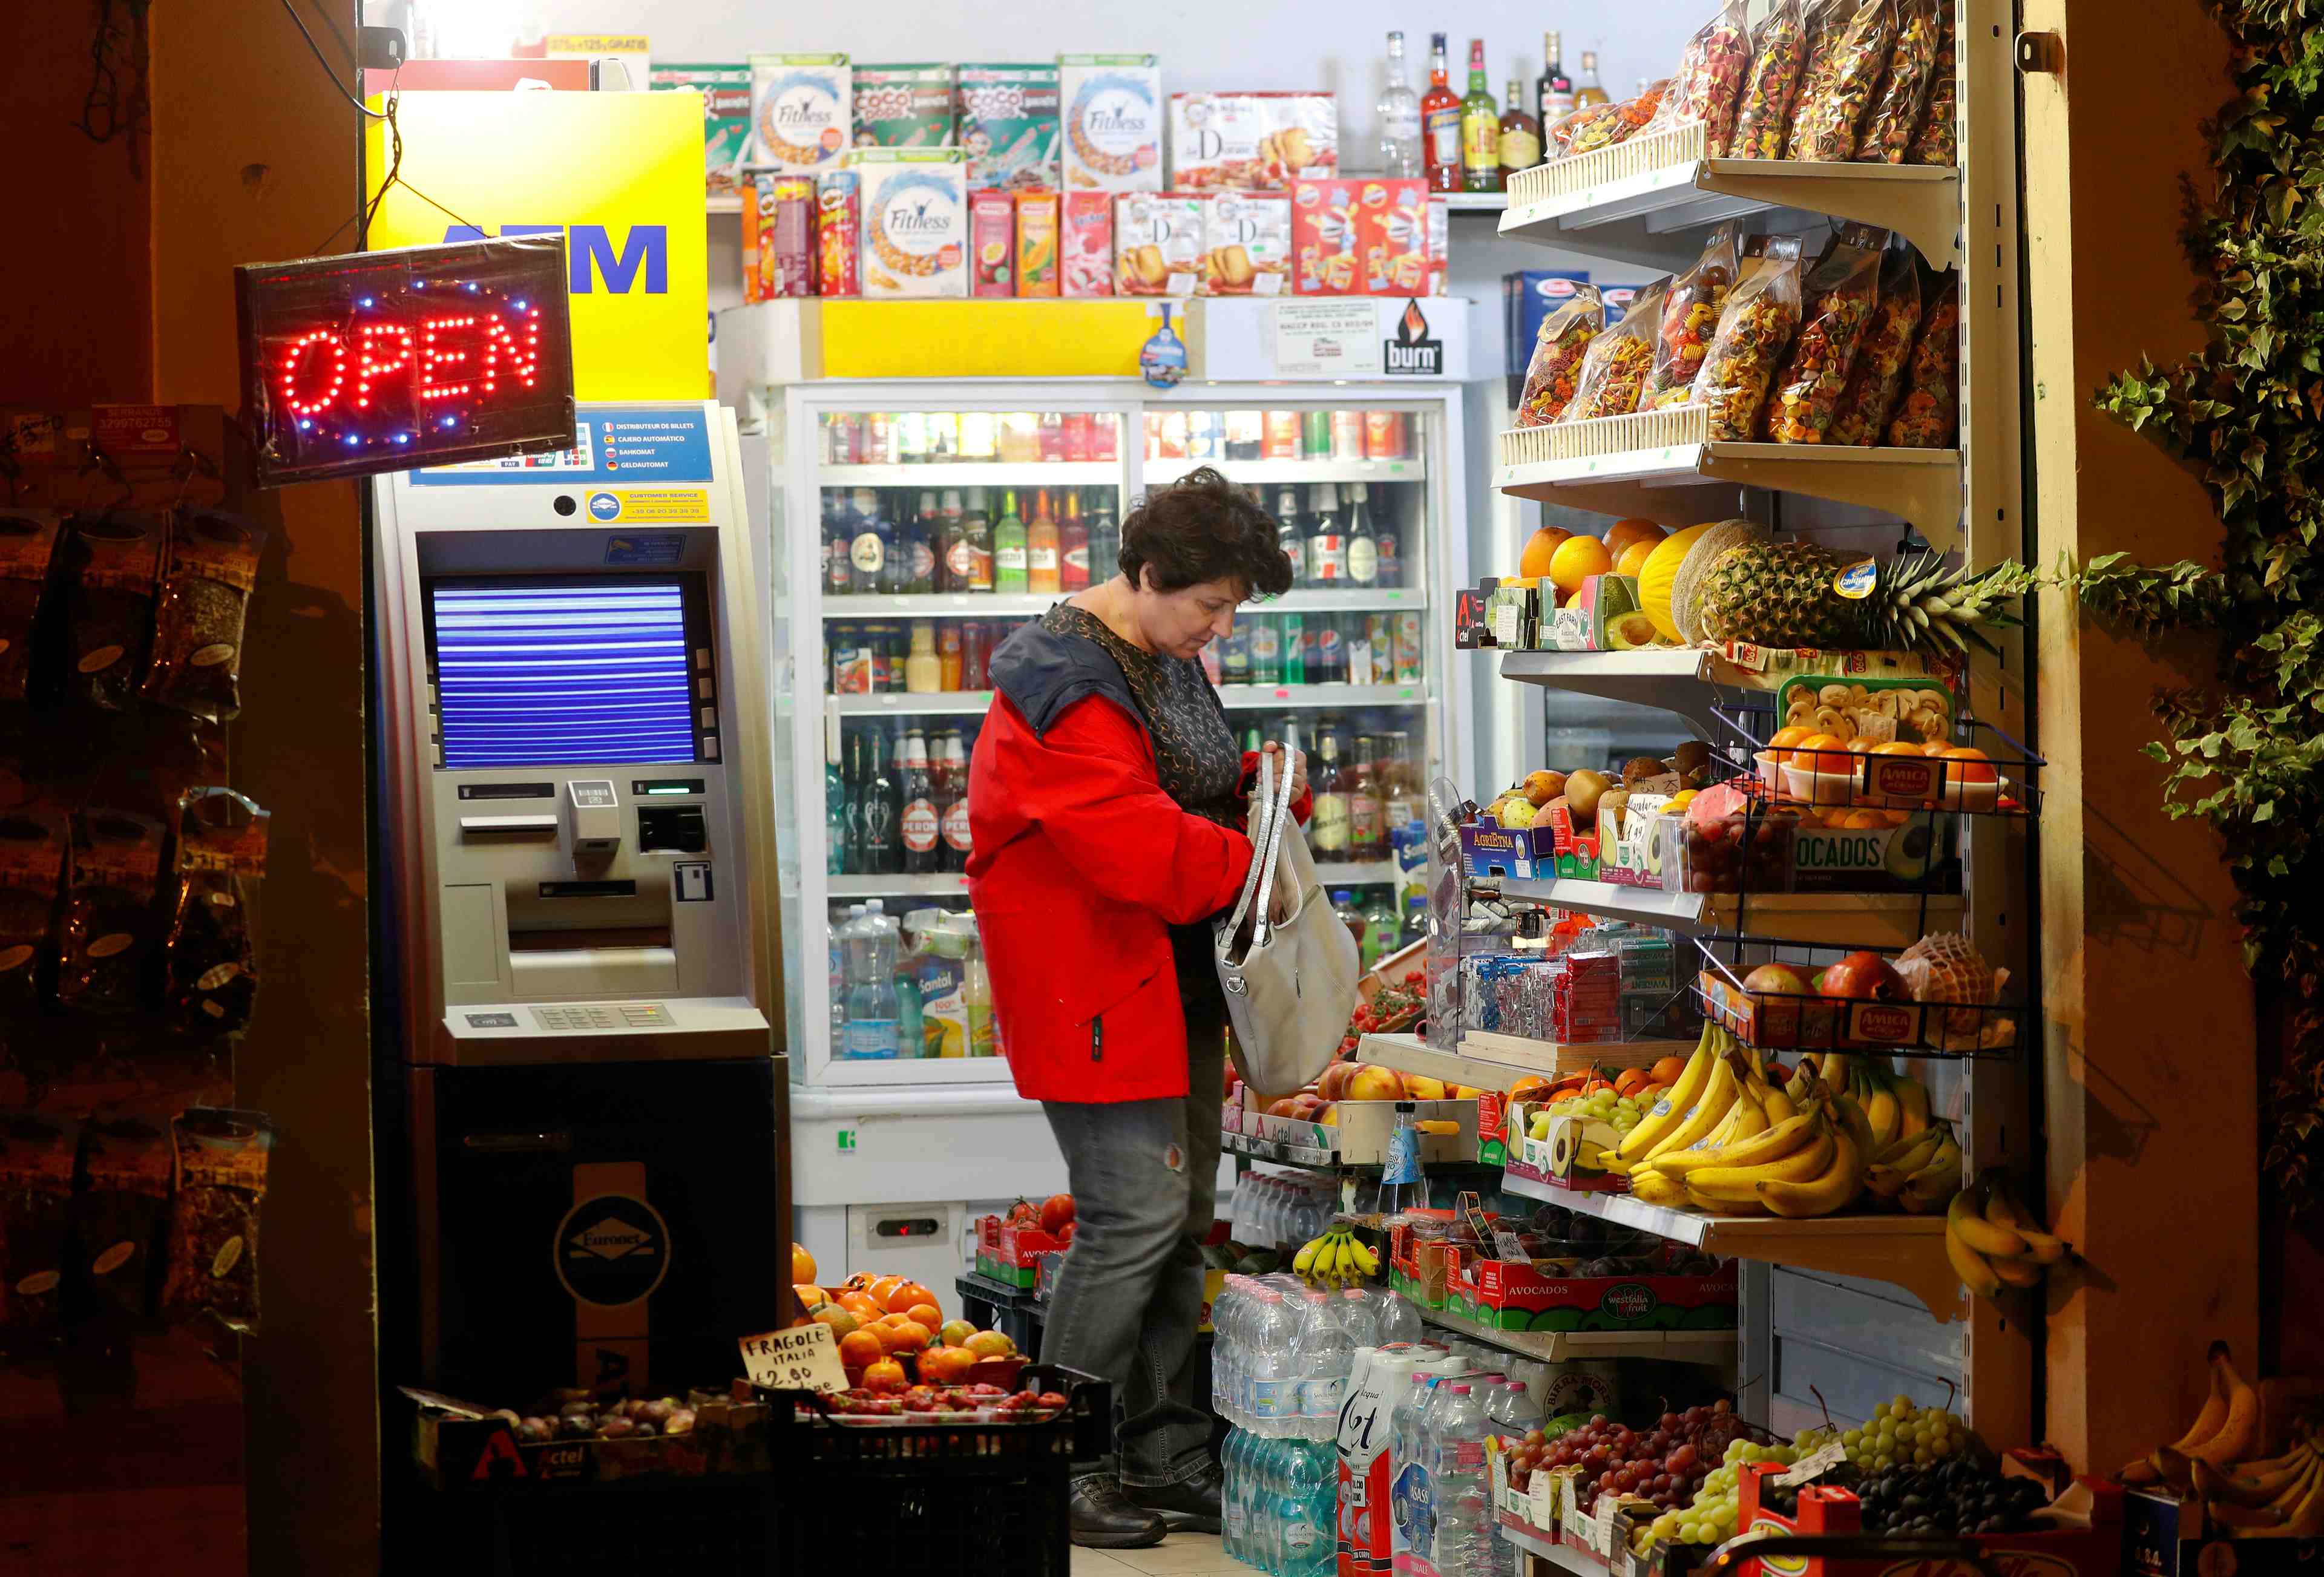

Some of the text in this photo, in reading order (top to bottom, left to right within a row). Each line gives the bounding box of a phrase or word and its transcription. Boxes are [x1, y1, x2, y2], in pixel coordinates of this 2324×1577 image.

[891, 208, 950, 229] Fitness
[284, 309, 539, 416] OPEN
[1388, 341, 1435, 368] burn
[1457, 593, 1470, 626] A
[1882, 766, 1929, 780] AMICA
[1473, 831, 1514, 848] AGRIETNA
[1796, 837, 1880, 867] OCADOS
[919, 971, 953, 995] Santal
[1862, 1012, 1909, 1028] AMICA
[1272, 1123, 1291, 1144] Actel
[584, 1231, 640, 1246] Euronet
[1509, 1285, 1569, 1296] AVOCADOS
[1608, 1294, 1649, 1305] westfalia
[1628, 1302, 1649, 1313] fruit
[745, 1327, 826, 1356] FRAGOLE
[773, 1348, 815, 1366] ITALIA
[1548, 1375, 1578, 1405] BIRRA
